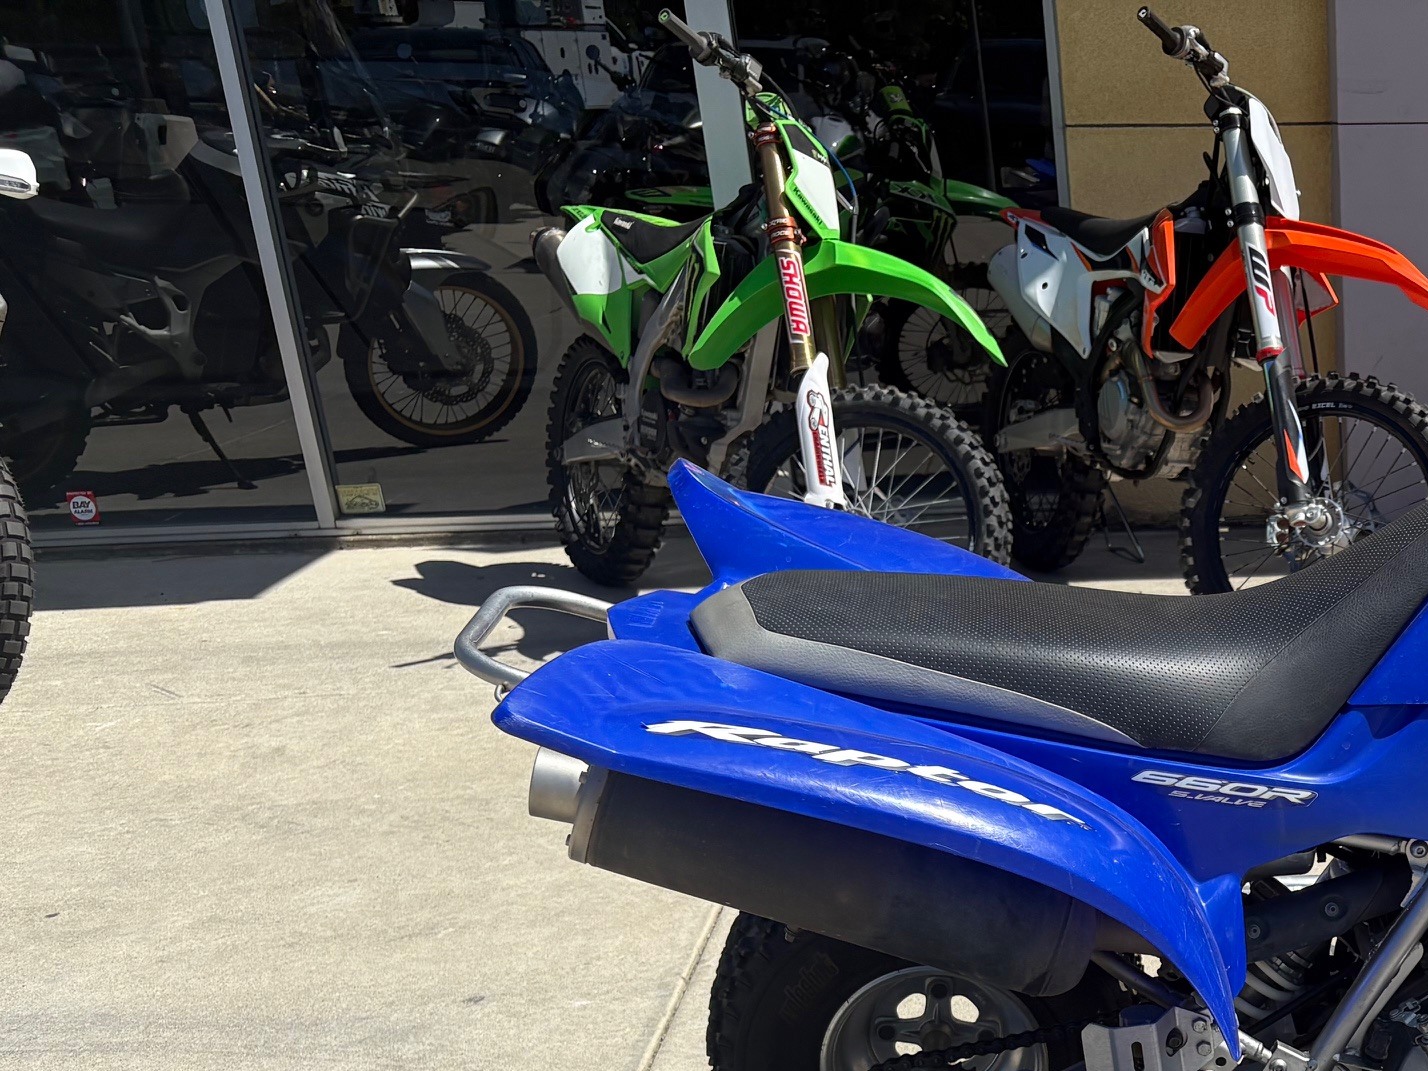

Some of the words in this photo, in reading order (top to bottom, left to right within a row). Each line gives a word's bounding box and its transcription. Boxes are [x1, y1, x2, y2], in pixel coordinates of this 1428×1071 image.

[792, 186, 823, 225] Kawasaki
[778, 256, 811, 337] SHOWA
[72, 500, 91, 509] BAY
[641, 719, 1096, 831] Raptor
[1130, 769, 1314, 805] 660R
